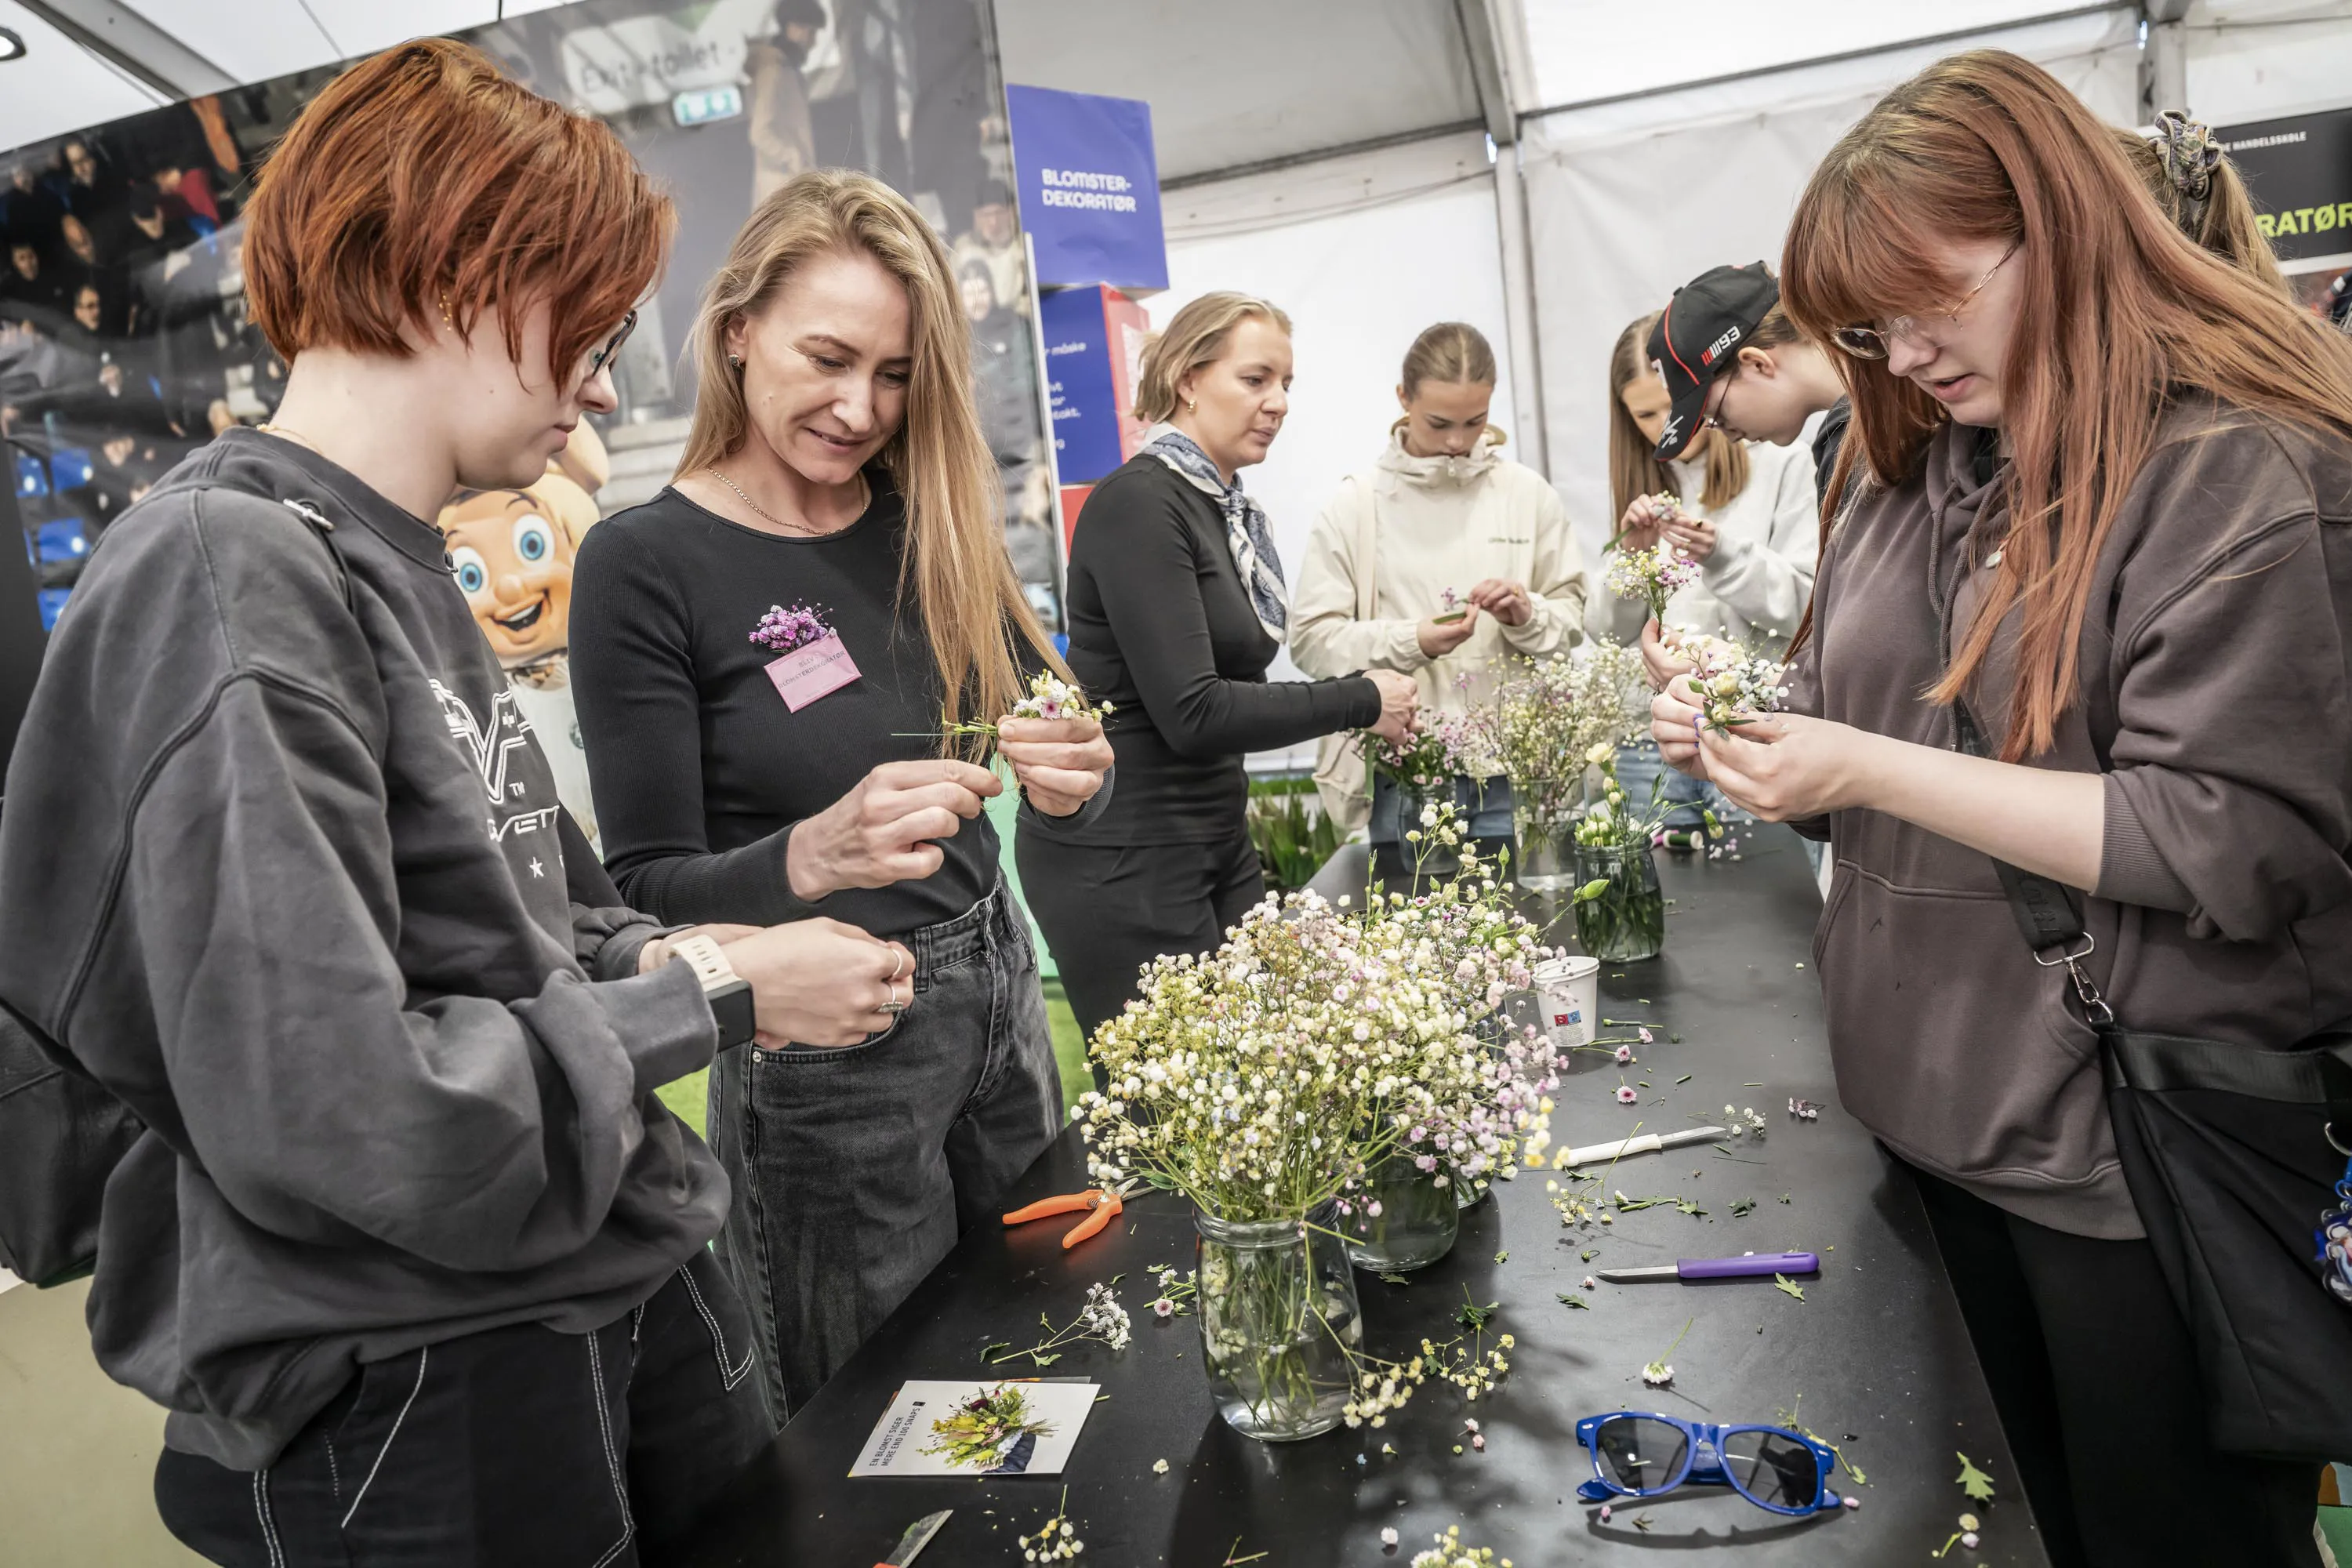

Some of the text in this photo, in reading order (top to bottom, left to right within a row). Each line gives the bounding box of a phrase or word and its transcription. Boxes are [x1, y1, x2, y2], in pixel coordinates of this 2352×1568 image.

[1041, 168, 1132, 192] BLOMSTER-
[1041, 189, 1137, 212] DEKORATØR
[798, 656, 815, 668] BLIV
[869, 1417, 905, 1467] EN BLOMST SIGER
[880, 1450, 897, 1466] MERE
[891, 1437, 904, 1449] END
[898, 1427, 909, 1436] 100
[904, 1407, 921, 1425] SNAPS
